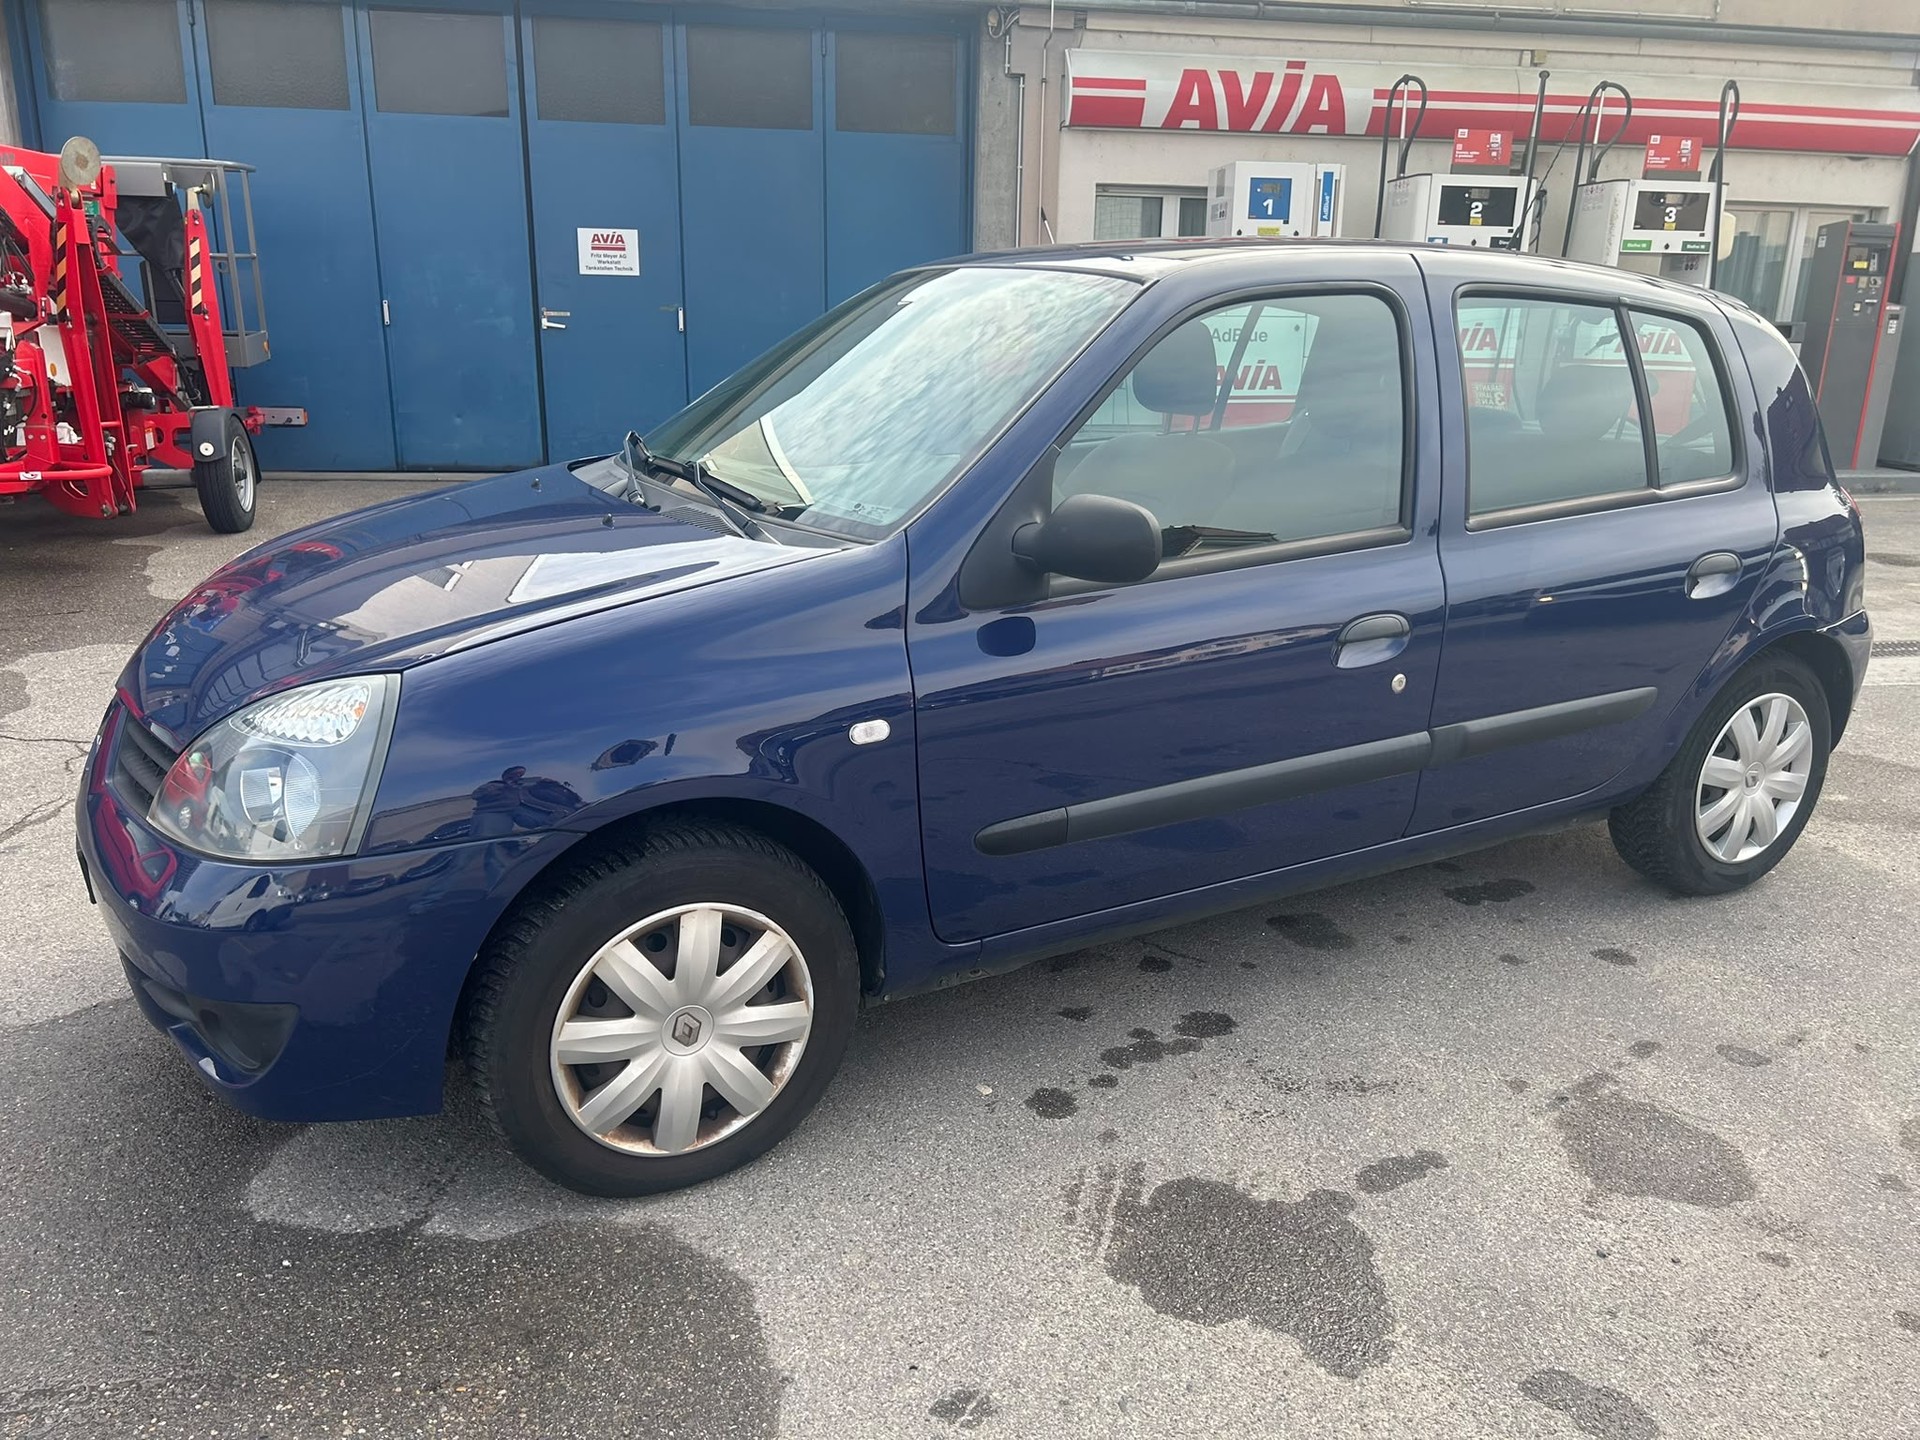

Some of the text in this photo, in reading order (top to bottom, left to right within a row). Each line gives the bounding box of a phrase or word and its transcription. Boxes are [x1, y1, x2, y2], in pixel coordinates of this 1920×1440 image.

[1161, 60, 1346, 135] AVIA
[1262, 198, 1274, 216] 1
[1469, 201, 1483, 217] 2
[1664, 206, 1677, 222] 3
[591, 231, 625, 244] AVIA
[1212, 328, 1268, 343] AdBue
